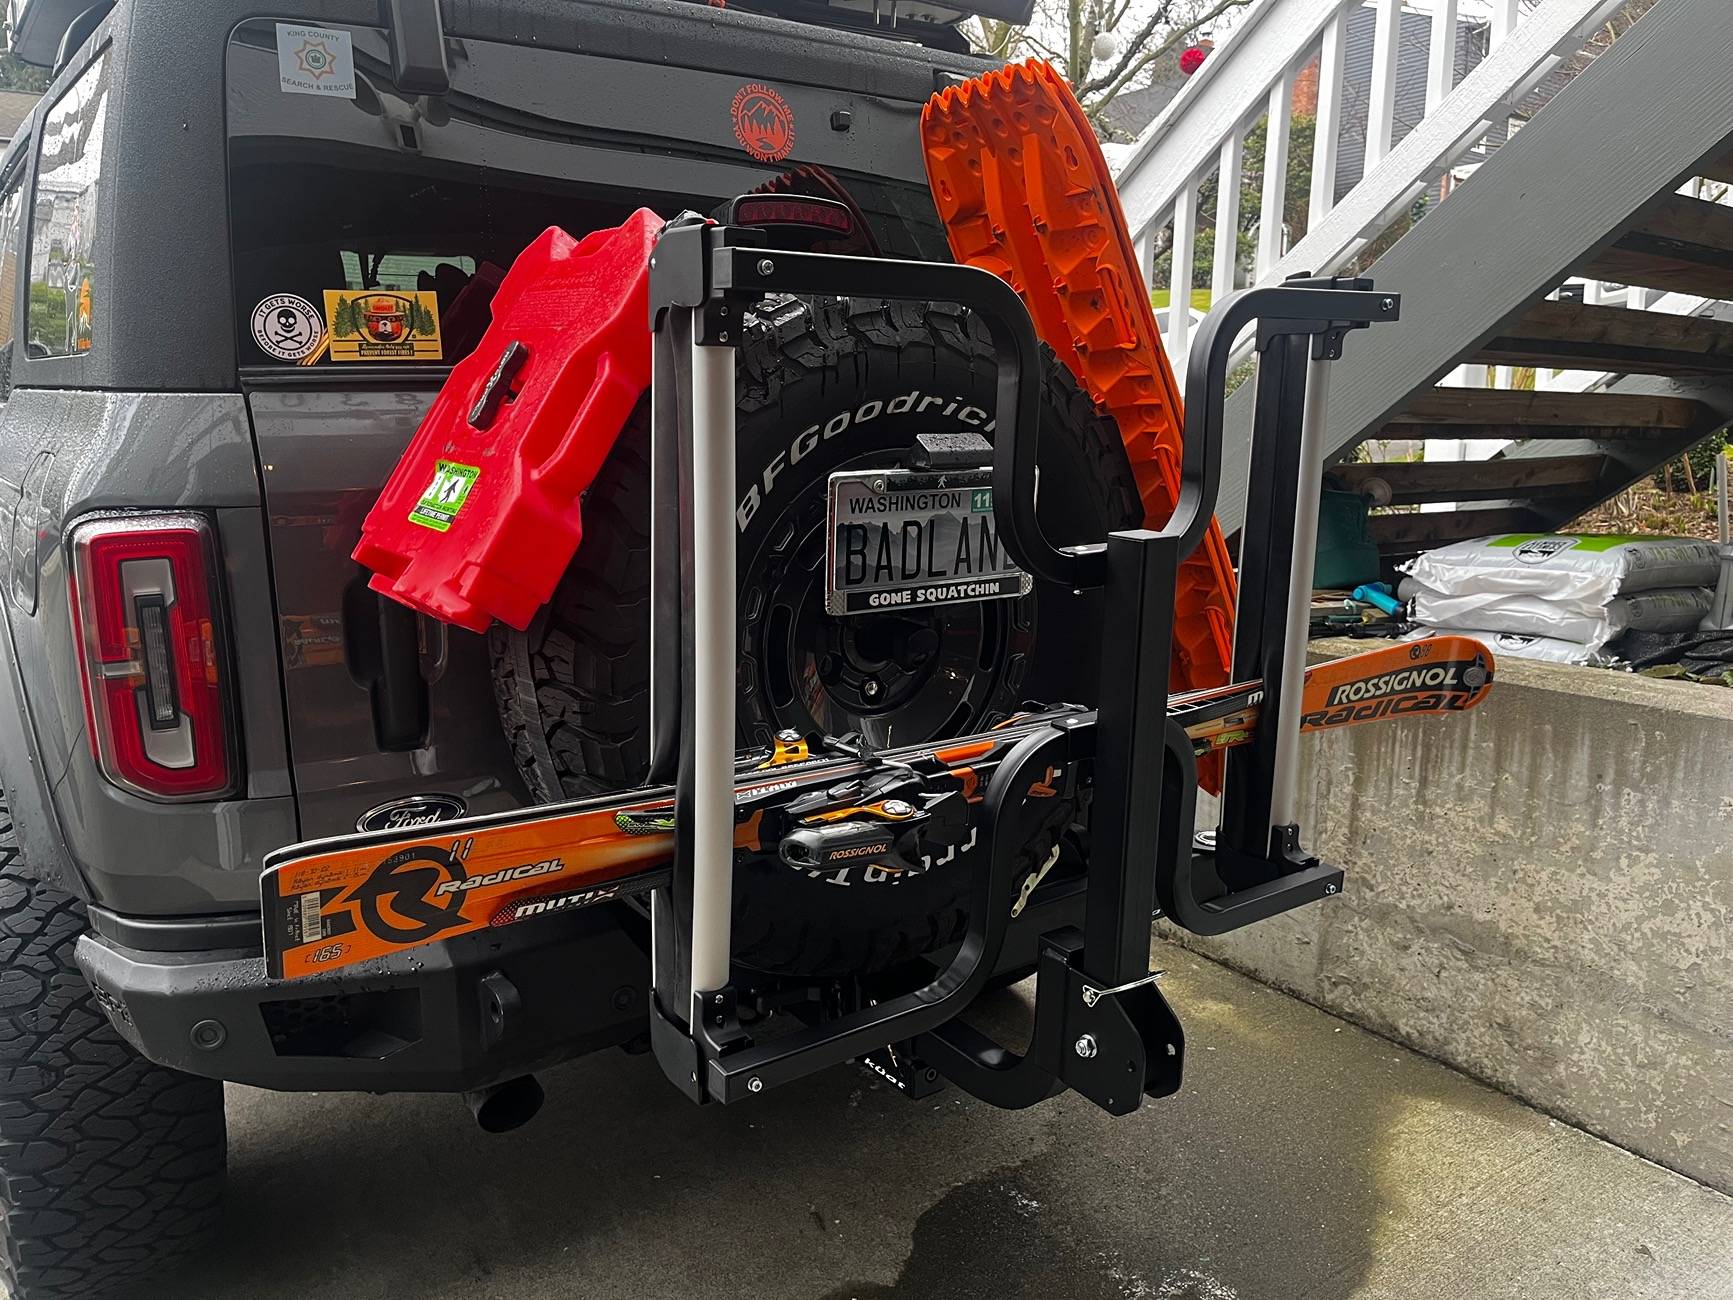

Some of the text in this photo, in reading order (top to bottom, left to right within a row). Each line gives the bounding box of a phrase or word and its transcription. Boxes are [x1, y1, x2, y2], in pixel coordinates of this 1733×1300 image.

[307, 31, 339, 41] COUNTY
[281, 77, 314, 90] SEARCH
[323, 83, 354, 92] RESCUE
[746, 83, 785, 104] FOLLOW
[732, 124, 747, 147] YOU
[264, 297, 286, 311] GETS
[287, 297, 316, 321] WORSE
[256, 329, 277, 354] BEFORE
[286, 346, 307, 358] GETS
[305, 329, 320, 351] WORSE
[438, 462, 478, 479] WASHINGTON
[736, 390, 996, 533] BFGoodric
[850, 493, 961, 514] WASHINGTON
[869, 583, 1000, 606] GONE SQUATCHIN
[1333, 667, 1459, 706] ROSSIGNOL
[384, 805, 442, 830] Ford
[829, 843, 887, 861] ROSSIGNOL
